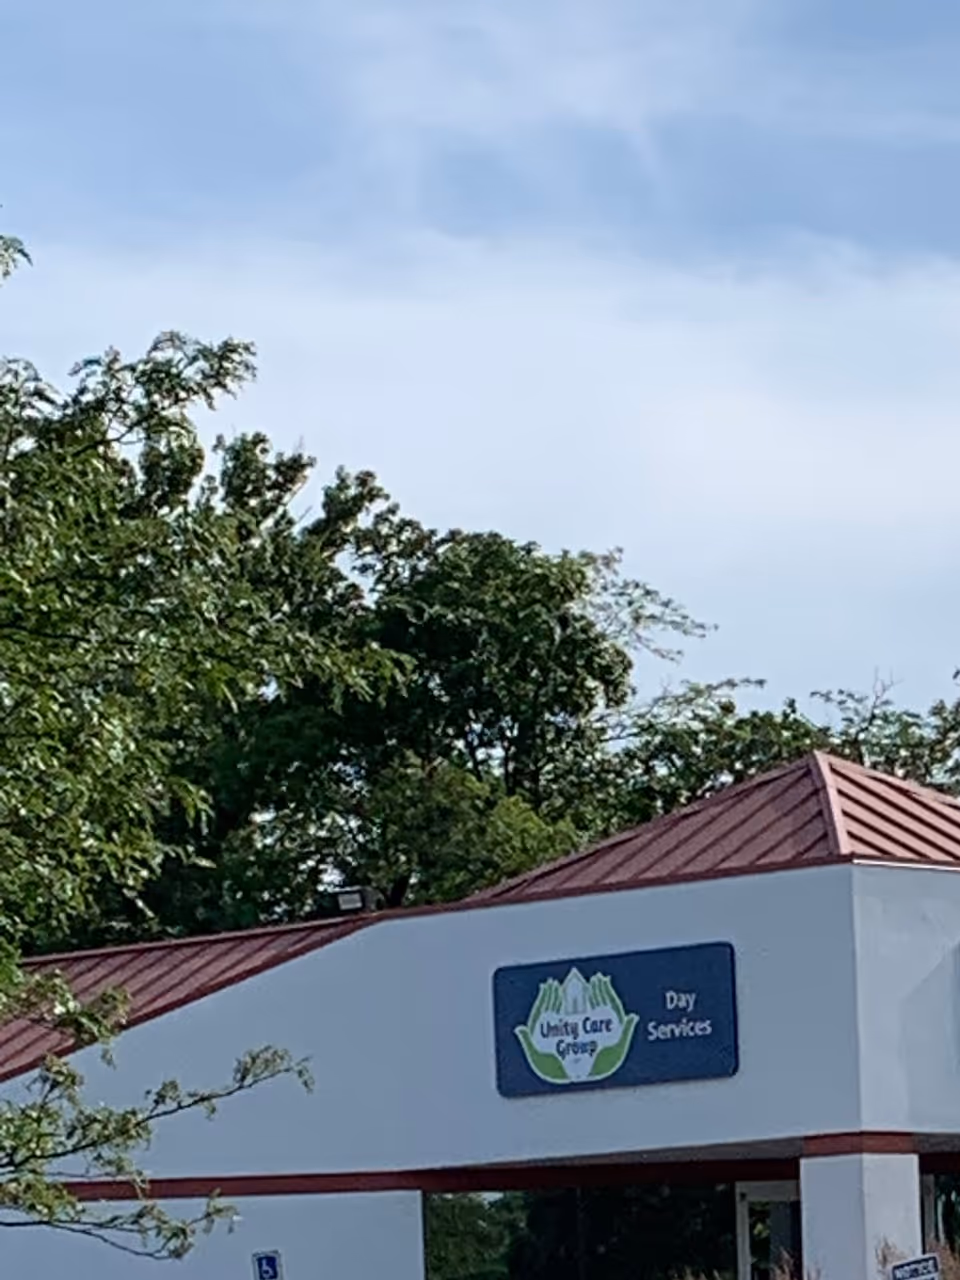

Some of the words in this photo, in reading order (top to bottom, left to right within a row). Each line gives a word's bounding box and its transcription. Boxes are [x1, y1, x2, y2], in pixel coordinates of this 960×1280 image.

[665, 989, 696, 1012] Day
[540, 1018, 580, 1039] Unity
[582, 1016, 613, 1033] Care
[647, 1016, 713, 1041] Services
[556, 1040, 598, 1060] Group
